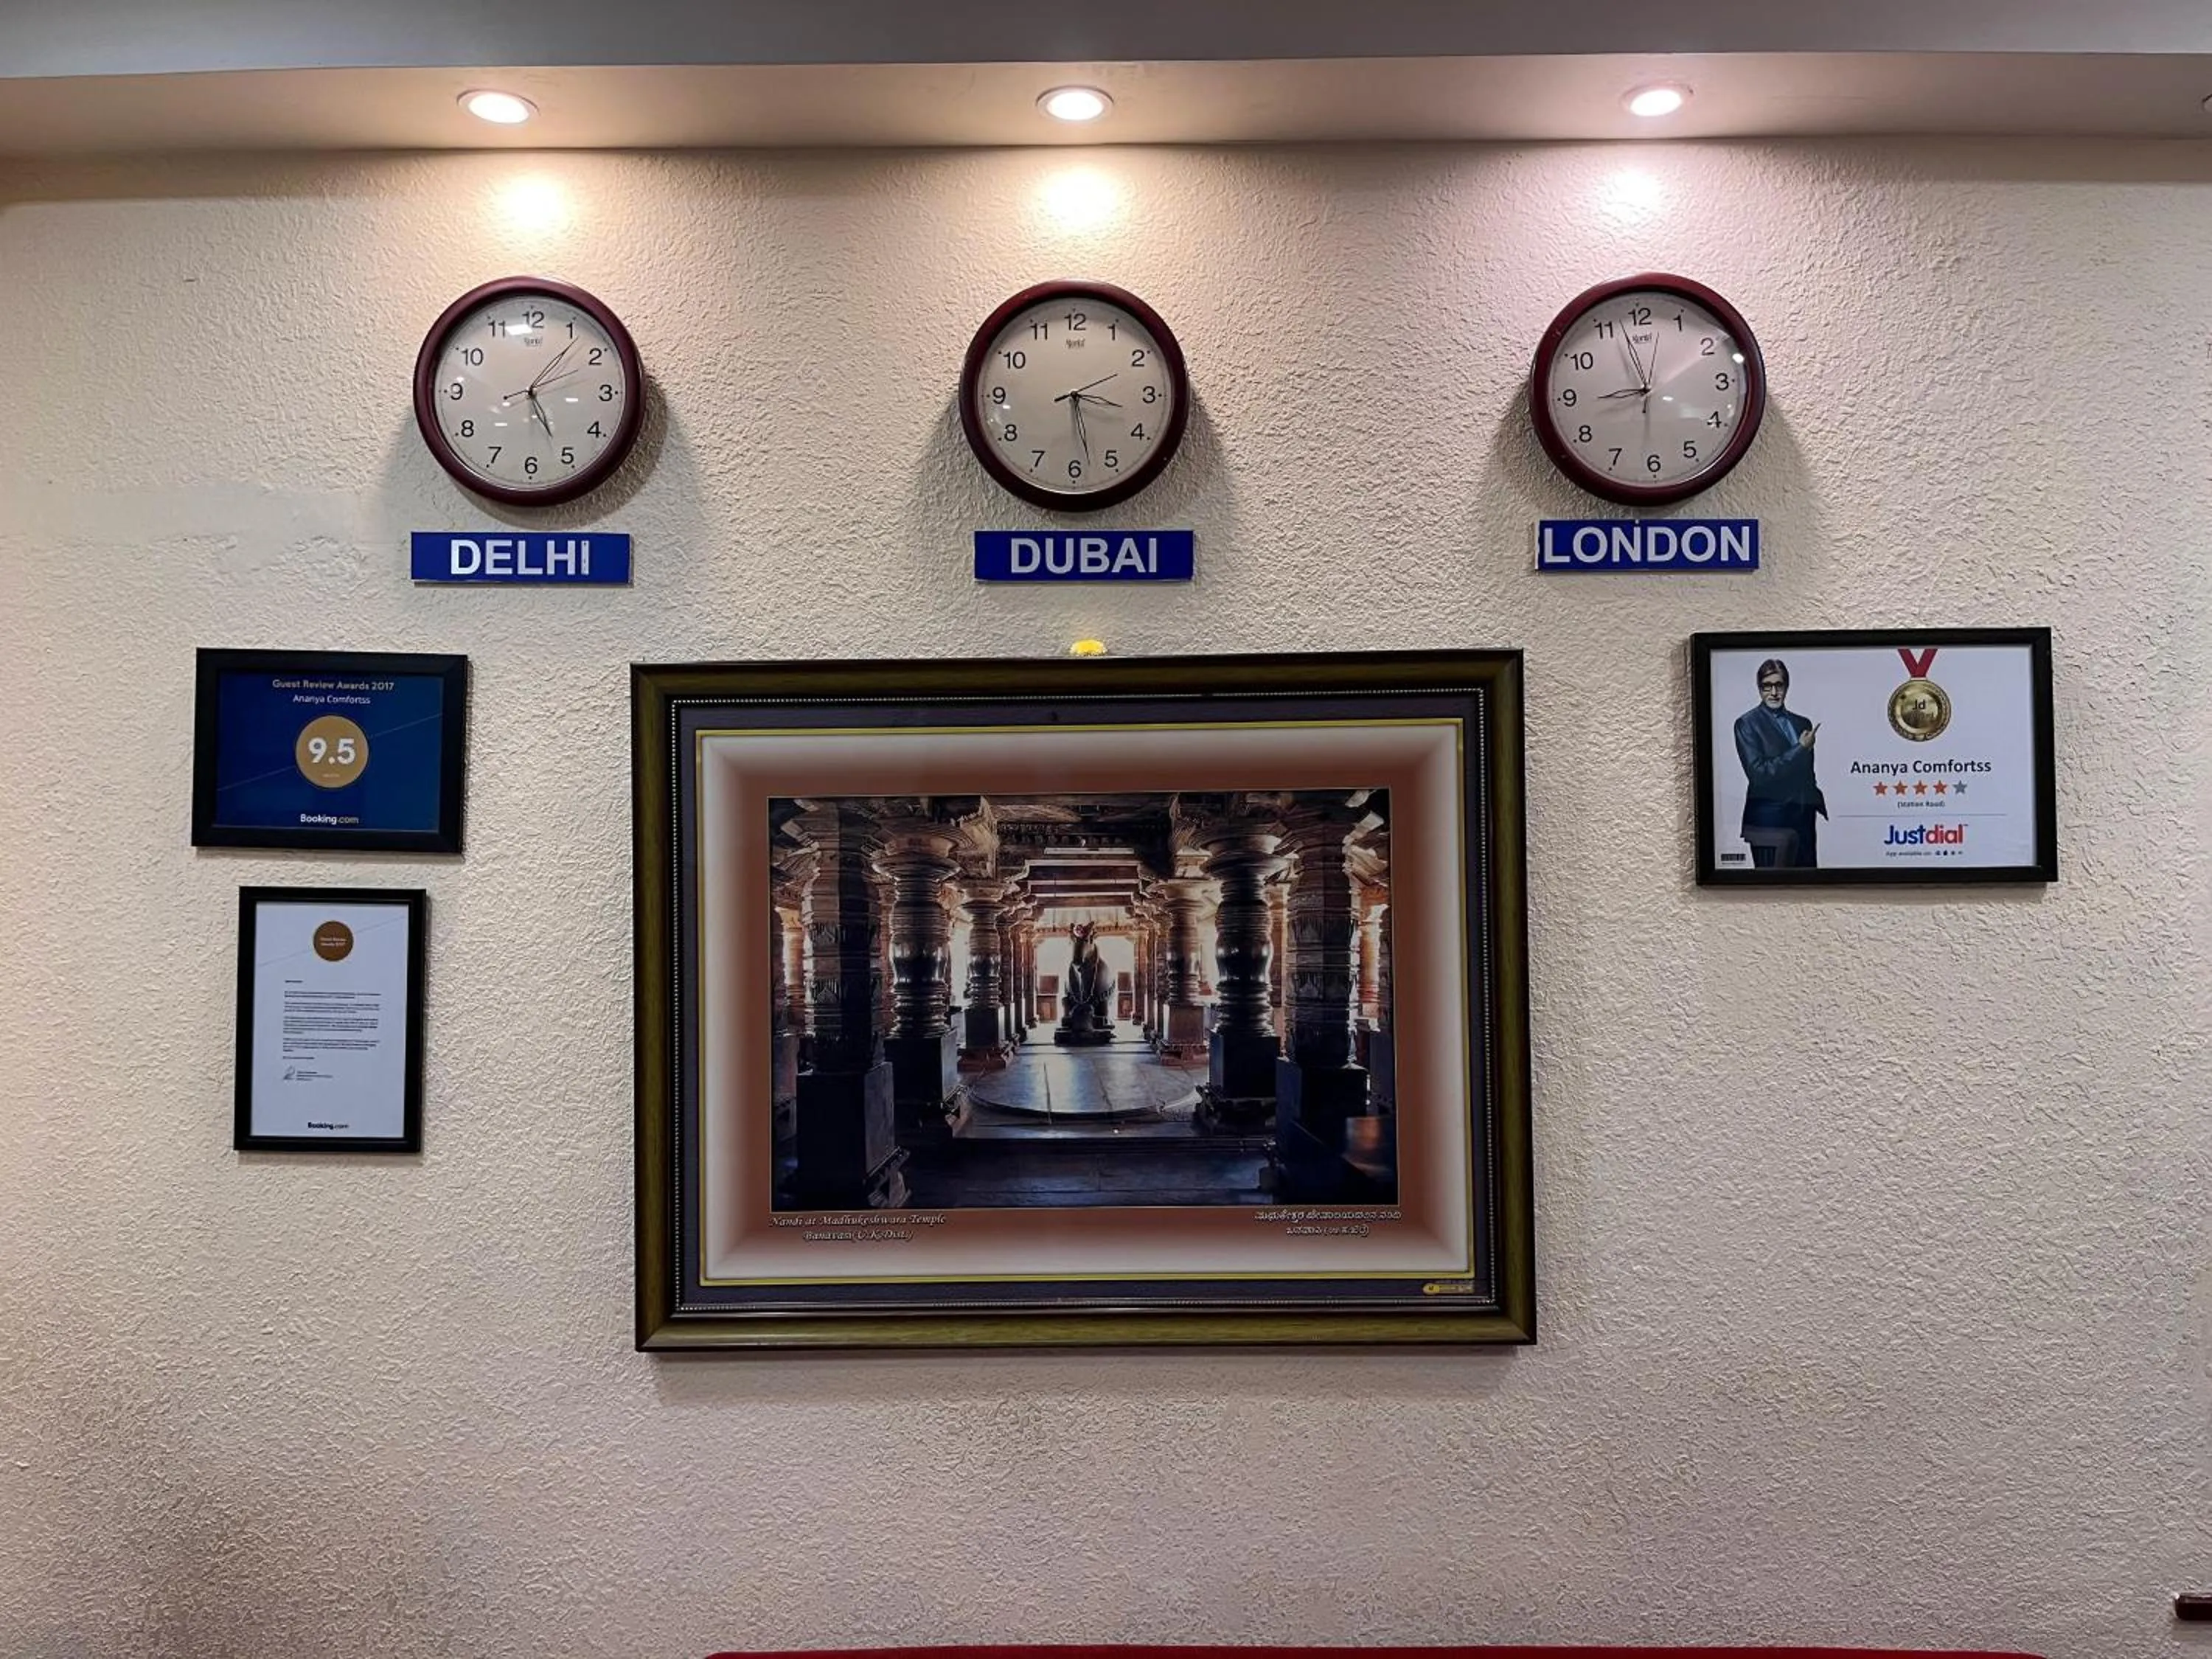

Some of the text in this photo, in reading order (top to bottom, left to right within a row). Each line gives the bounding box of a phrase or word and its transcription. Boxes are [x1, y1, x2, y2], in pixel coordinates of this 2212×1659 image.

[522, 311, 545, 329] 12
[1064, 313, 1086, 331] 12
[1628, 307, 1652, 325] 12
[1673, 315, 1683, 331] 1
[488, 321, 507, 338] 11
[566, 322, 574, 339] 1
[1030, 323, 1048, 340] 11
[1108, 324, 1116, 341] 1
[1595, 321, 1613, 339] 11
[1700, 338, 1714, 355] 2
[462, 348, 484, 366] 10
[588, 348, 602, 366] 2
[1004, 352, 1026, 369] 10
[1131, 349, 1145, 367] 2
[1570, 352, 1593, 370] 10
[1715, 373, 1729, 391] 3
[450, 383, 463, 400] 9
[599, 384, 613, 402] 3
[992, 387, 1006, 404] 9
[1142, 386, 1156, 403] 3
[1562, 389, 1576, 406] 9
[1706, 411, 1722, 428] 4
[461, 420, 474, 437] 8
[587, 421, 601, 438] 4
[1004, 424, 1018, 441] 8
[1130, 423, 1144, 440] 4
[1578, 425, 1593, 442] 8
[488, 447, 501, 463] 7
[561, 447, 574, 465] 5
[1608, 448, 1622, 465] 7
[1683, 440, 1697, 458] 5
[524, 456, 538, 474] 6
[1032, 451, 1045, 467] 7
[1105, 451, 1118, 467] 5
[1646, 455, 1660, 472] 6
[1068, 461, 1082, 478] 6
[1544, 526, 1750, 563] LONDON
[451, 539, 590, 575] DELHI
[1011, 538, 1158, 574] DUBAI
[272, 679, 394, 691] Guest Review Awards 2017
[293, 695, 371, 704] Ananya Comfortss
[308, 737, 355, 764] 9.5
[1851, 759, 1992, 776] Ananya Comfortss
[300, 813, 359, 825] Booking.com
[1884, 824, 1963, 844] Justdial
[307, 1121, 349, 1130] Booking.com
[908, 1214, 945, 1226] Temple
